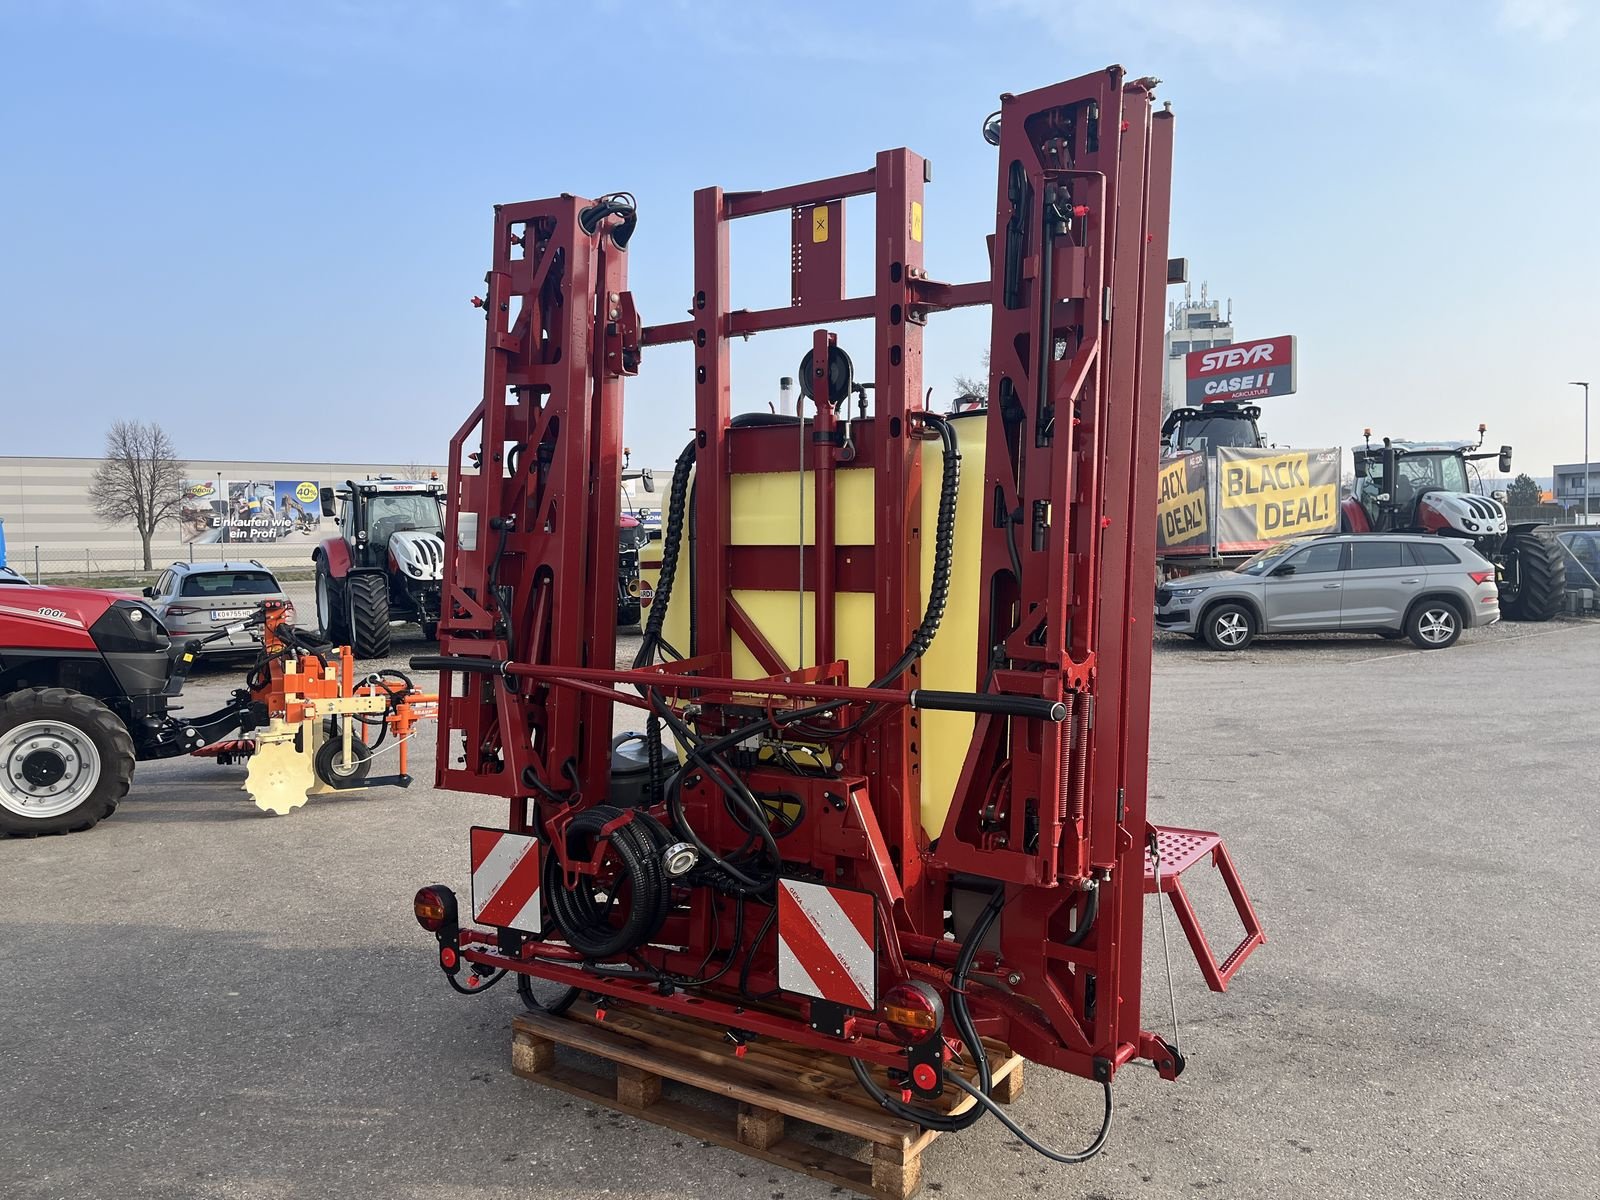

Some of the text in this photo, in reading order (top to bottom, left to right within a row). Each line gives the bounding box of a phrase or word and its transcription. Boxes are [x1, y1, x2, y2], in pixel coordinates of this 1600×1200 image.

[1200, 343, 1274, 372] STEYR
[1205, 375, 1254, 394] CASE
[1231, 388, 1269, 398] AGRICULTURE
[1227, 459, 1305, 497] BLACK
[296, 487, 317, 496] 40%
[1264, 493, 1329, 531] DEAL!
[269, 517, 291, 527] wie
[229, 528, 277, 538] ein Profi
[789, 887, 803, 905] GEKA
[837, 953, 851, 972] GEKA
